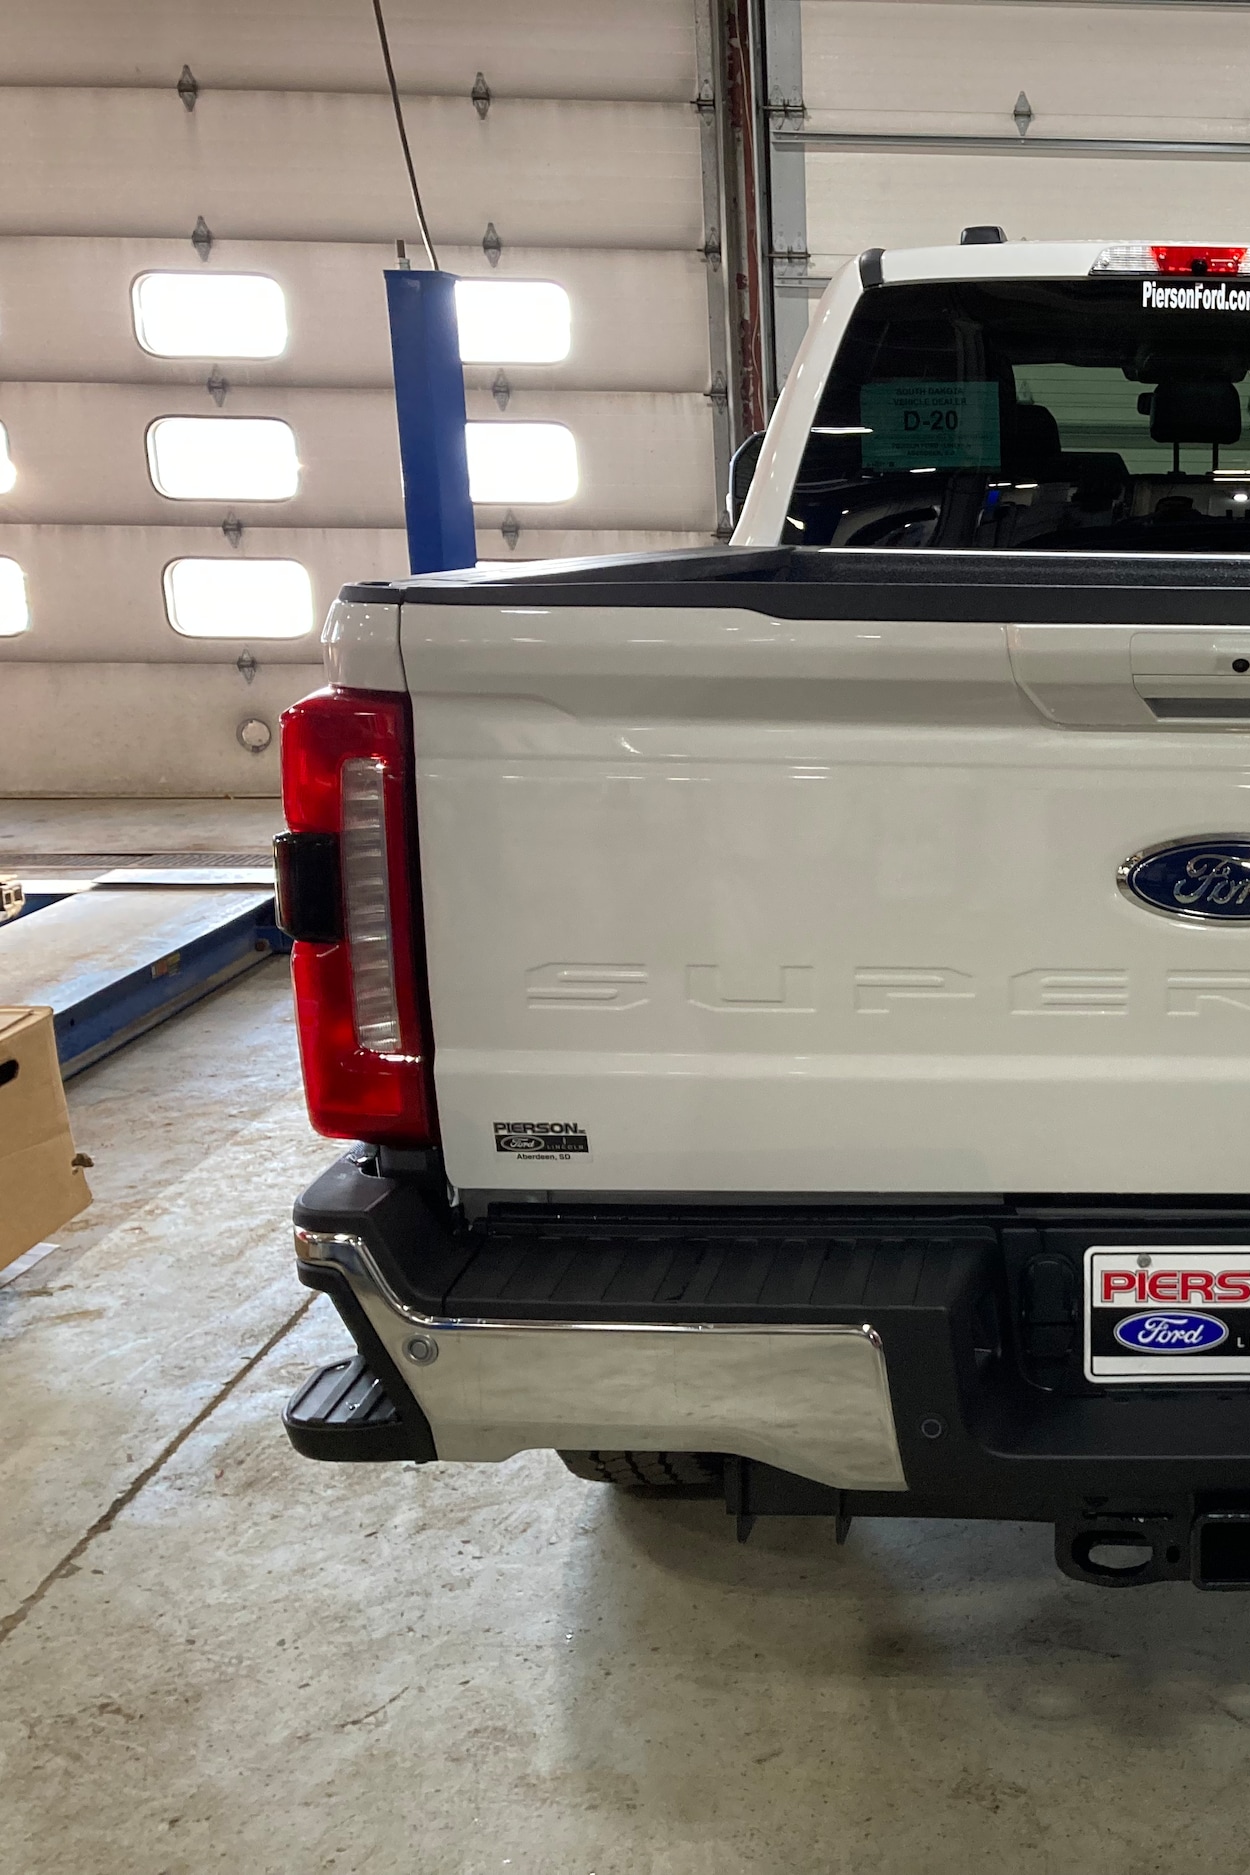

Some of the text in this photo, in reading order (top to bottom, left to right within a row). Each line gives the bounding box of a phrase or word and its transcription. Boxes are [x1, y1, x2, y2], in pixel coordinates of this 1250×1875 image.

[903, 410, 958, 431] D-20
[493, 1122, 578, 1134] PIERSON
[509, 1138, 535, 1149] Ford
[516, 1153, 558, 1161] Aberdeen,
[1137, 1316, 1203, 1345] Ford
